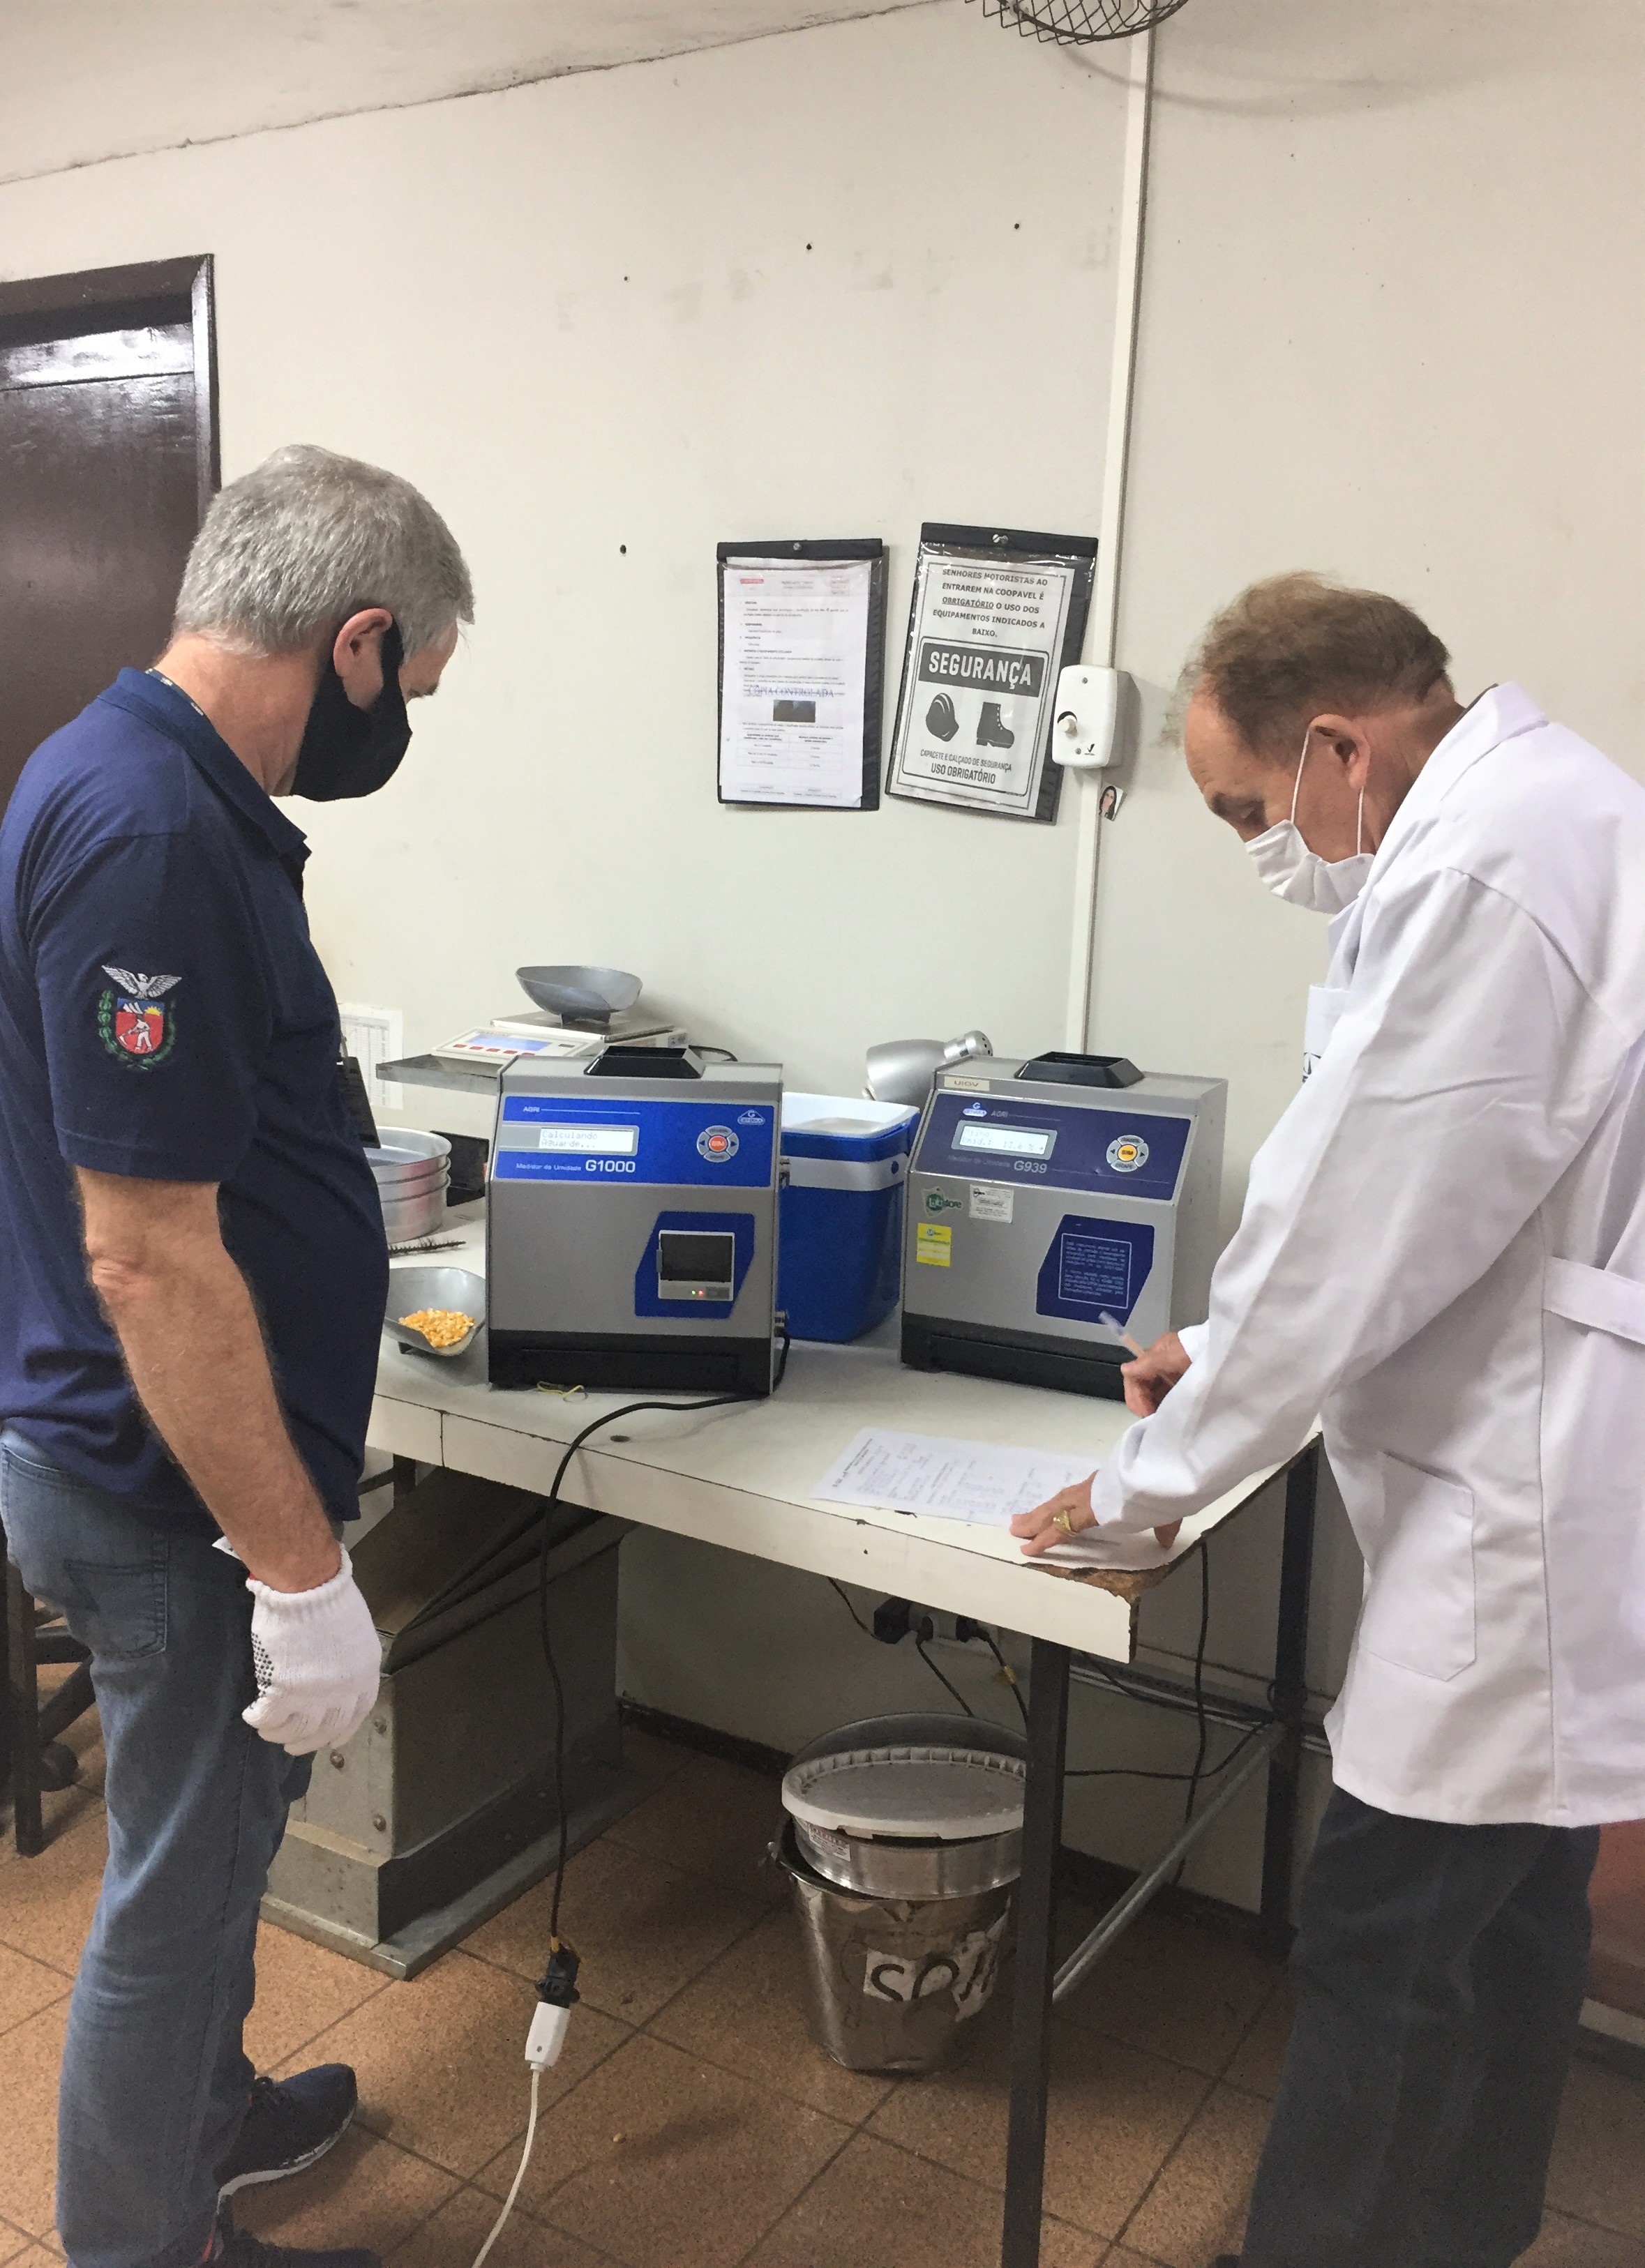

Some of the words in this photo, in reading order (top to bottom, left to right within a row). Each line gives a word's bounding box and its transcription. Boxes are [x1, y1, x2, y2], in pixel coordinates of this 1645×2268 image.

[942, 568, 982, 580] SENHORES
[984, 572, 1035, 584] MOTORISTAS
[1036, 578, 1048, 587] AO
[942, 582, 982, 594] ENTRAREM
[996, 588, 1037, 600] COOPAVEL
[1039, 591, 1044, 600] É
[942, 596, 994, 610] OBRIGATÓRIO
[1004, 603, 1021, 612] USO
[1023, 605, 1039, 614] DOS
[933, 609, 990, 622] EQUIPAMENTOS
[991, 616, 1037, 628] INDICADOS
[972, 628, 998, 637] BAIXO.
[929, 651, 1032, 690] SEGURANÇA
[920, 748, 944, 761] CAPACETE
[949, 754, 972, 765] CALÇADO
[972, 758, 980, 766] DE
[980, 759, 1012, 773] SEGURANÇA
[931, 762, 946, 775] USO
[947, 766, 996, 785] OBRIGATÓRIO
[991, 1110, 1009, 1118] AGRI
[542, 1130, 598, 1140] Calculando
[585, 1159, 636, 1173] G1000
[1014, 1160, 1047, 1174] G939
